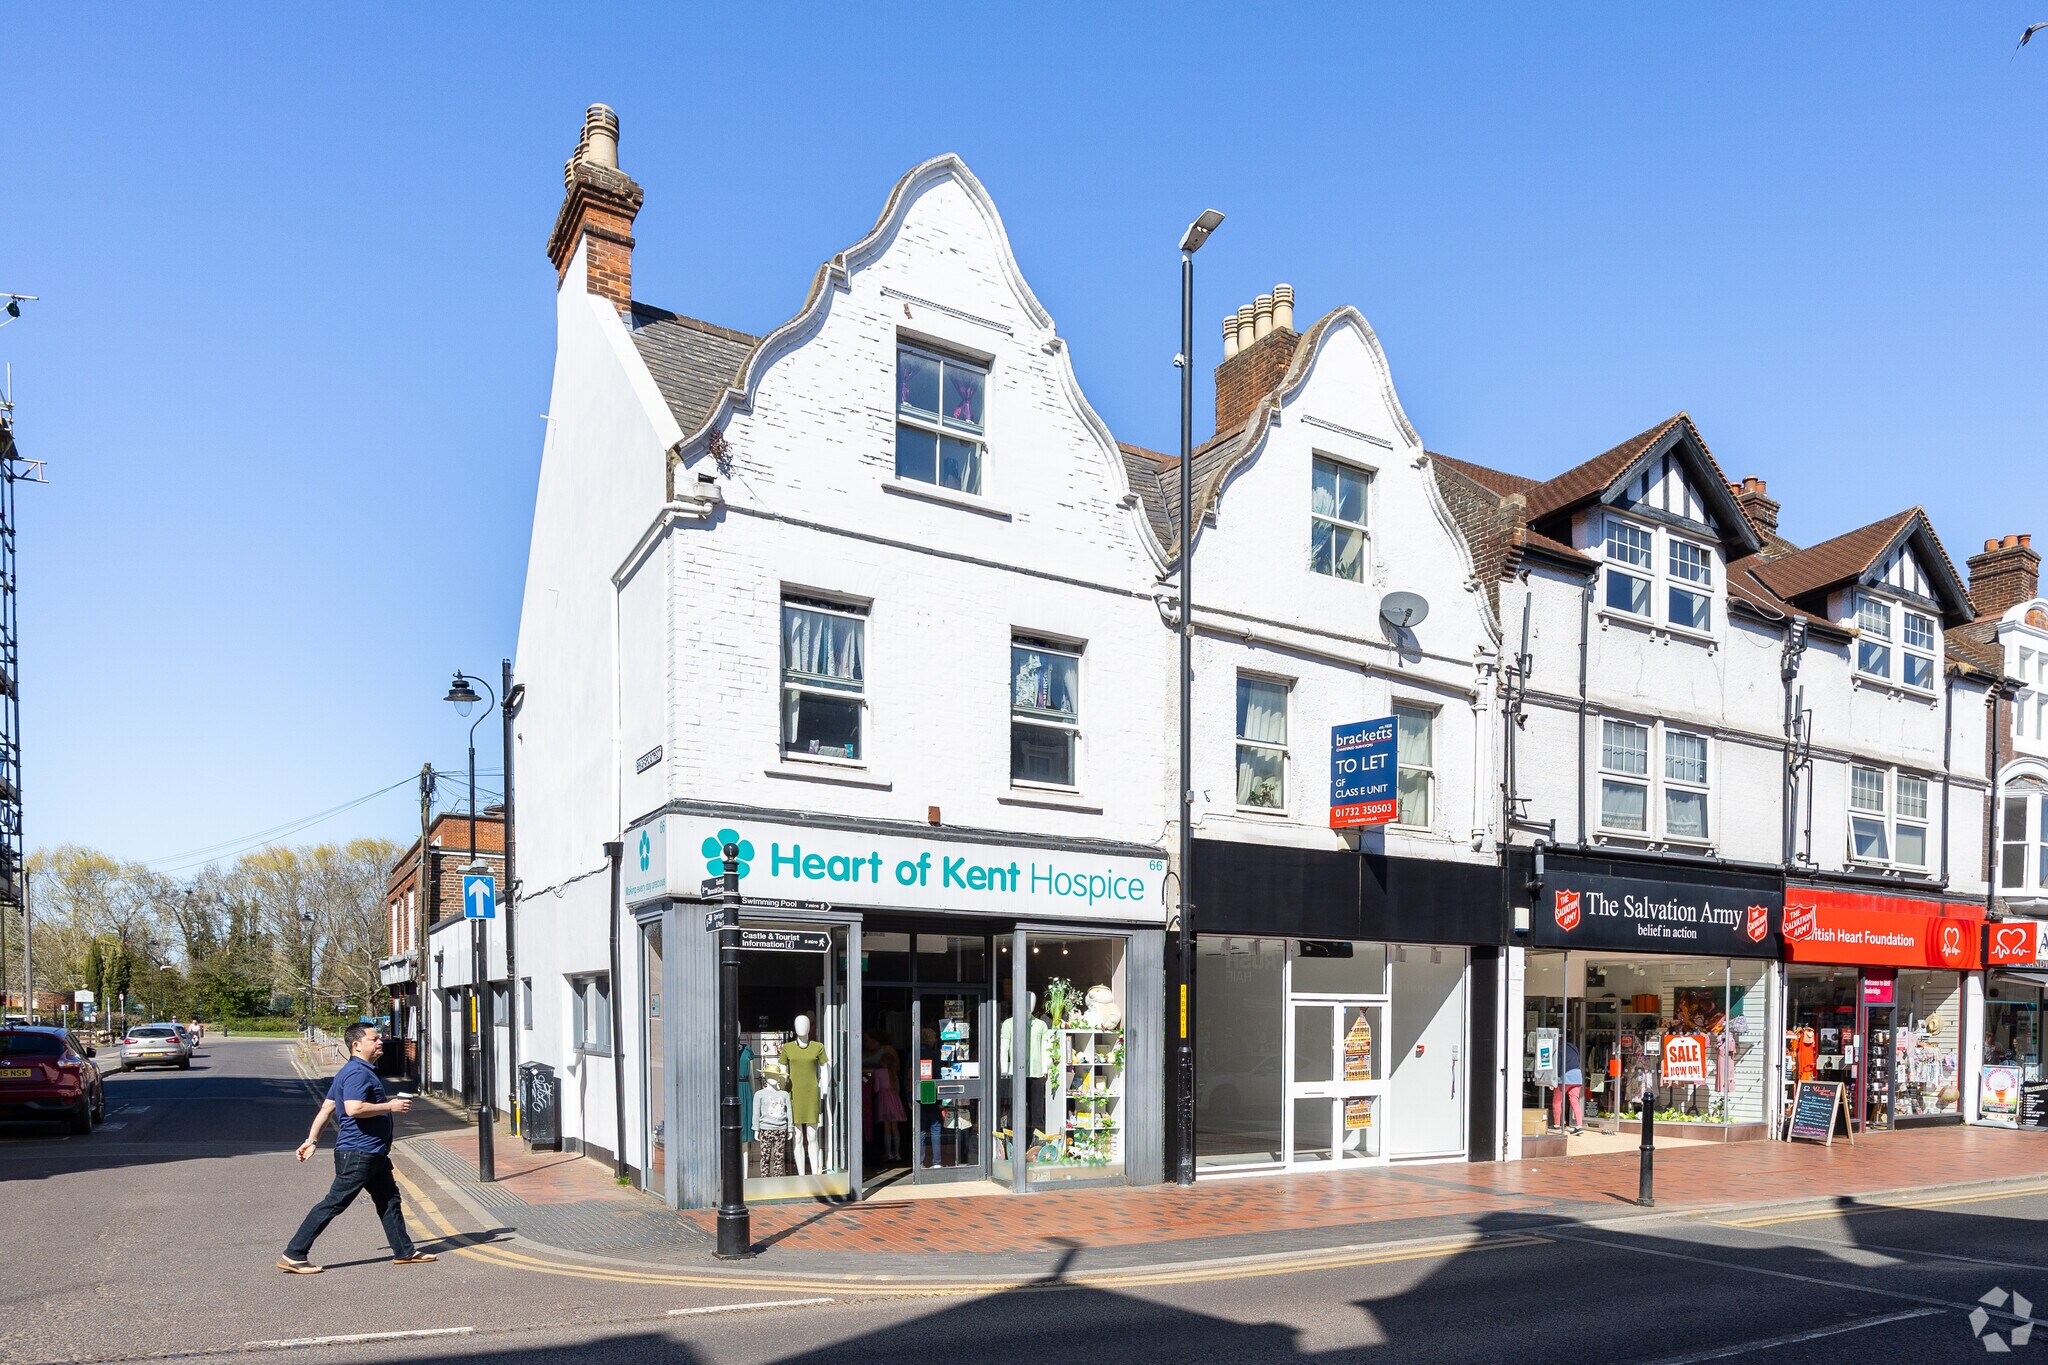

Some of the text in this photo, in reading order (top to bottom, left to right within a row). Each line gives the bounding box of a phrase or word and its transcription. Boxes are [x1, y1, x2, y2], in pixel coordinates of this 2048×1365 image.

[1336, 728, 1392, 746] bracketts
[1336, 753, 1388, 774] TO LET
[1336, 778, 1346, 787] GF
[1335, 784, 1388, 798] CLASS E UNIT
[1335, 803, 1392, 817] 01732 350503
[1149, 860, 1163, 871] 66
[771, 842, 1145, 906] Heart of Kent Hospice
[741, 896, 779, 907] Swimming
[1560, 894, 1569, 905] THE
[1555, 898, 1578, 919] SALVATION
[1586, 892, 1743, 931] The Salvation Army
[1790, 909, 1801, 919] THE
[1563, 910, 1577, 925] ARMY
[1784, 910, 1812, 932] SALVATION
[742, 931, 766, 939] Castle
[774, 933, 800, 941] Tourist
[1638, 923, 1697, 939] belief in action
[1793, 922, 1810, 937] ARMY
[742, 940, 784, 948] Information
[1837, 929, 1863, 943] Heart
[1865, 931, 1915, 947] Foundation
[1669, 1045, 1699, 1063] SALE
[11, 1069, 28, 1077] NSK
[1345, 1069, 1370, 1077] TONBRIDGE
[1670, 1065, 1700, 1076] NOW ON!
[1346, 1113, 1371, 1121] TONBRIDGE
